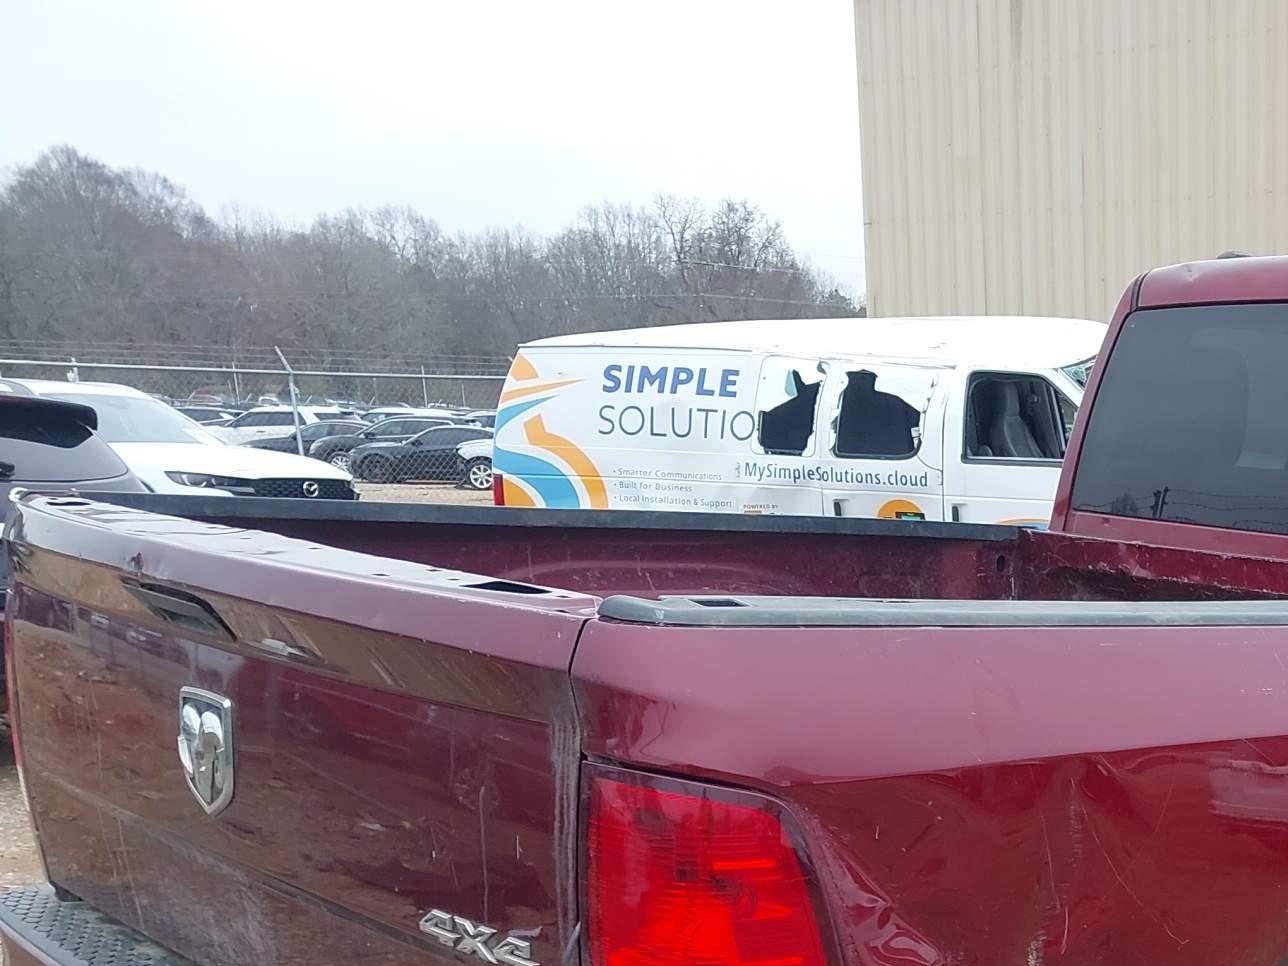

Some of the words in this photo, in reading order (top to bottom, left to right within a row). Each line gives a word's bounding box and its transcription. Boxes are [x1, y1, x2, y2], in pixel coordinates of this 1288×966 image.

[602, 364, 740, 398] SIMPLE
[598, 404, 756, 441] SOLUTIO
[618, 467, 652, 477] Smarter
[655, 470, 722, 481] Communications
[744, 462, 928, 487] MySimpleSolutions.cloud
[619, 481, 637, 489] Built
[655, 483, 693, 492] Business
[619, 495, 640, 503] Local
[641, 495, 691, 506] Installation
